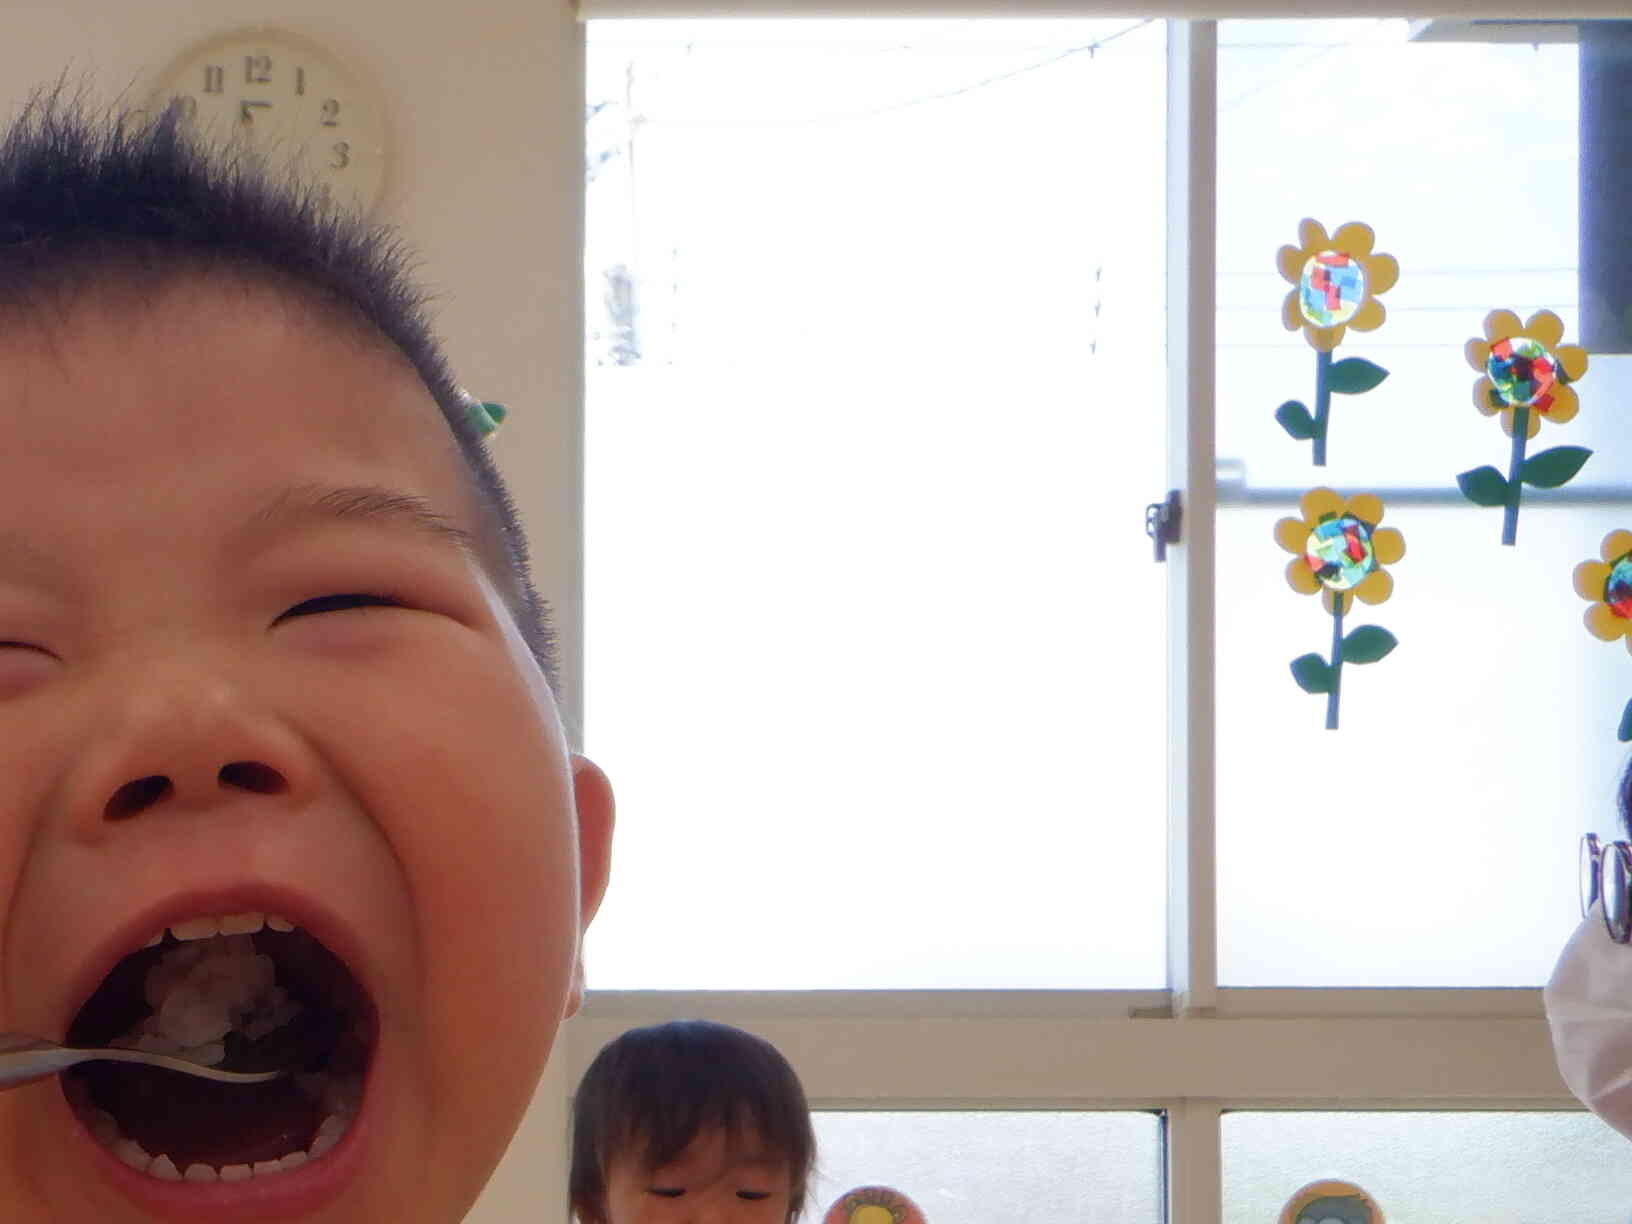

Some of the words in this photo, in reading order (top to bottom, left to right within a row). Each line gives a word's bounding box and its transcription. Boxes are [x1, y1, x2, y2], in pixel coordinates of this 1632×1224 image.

[203, 65, 224, 94] 11
[244, 55, 272, 84] 12
[294, 67, 306, 96] 1
[321, 98, 340, 127] 2
[330, 141, 350, 169] 3
